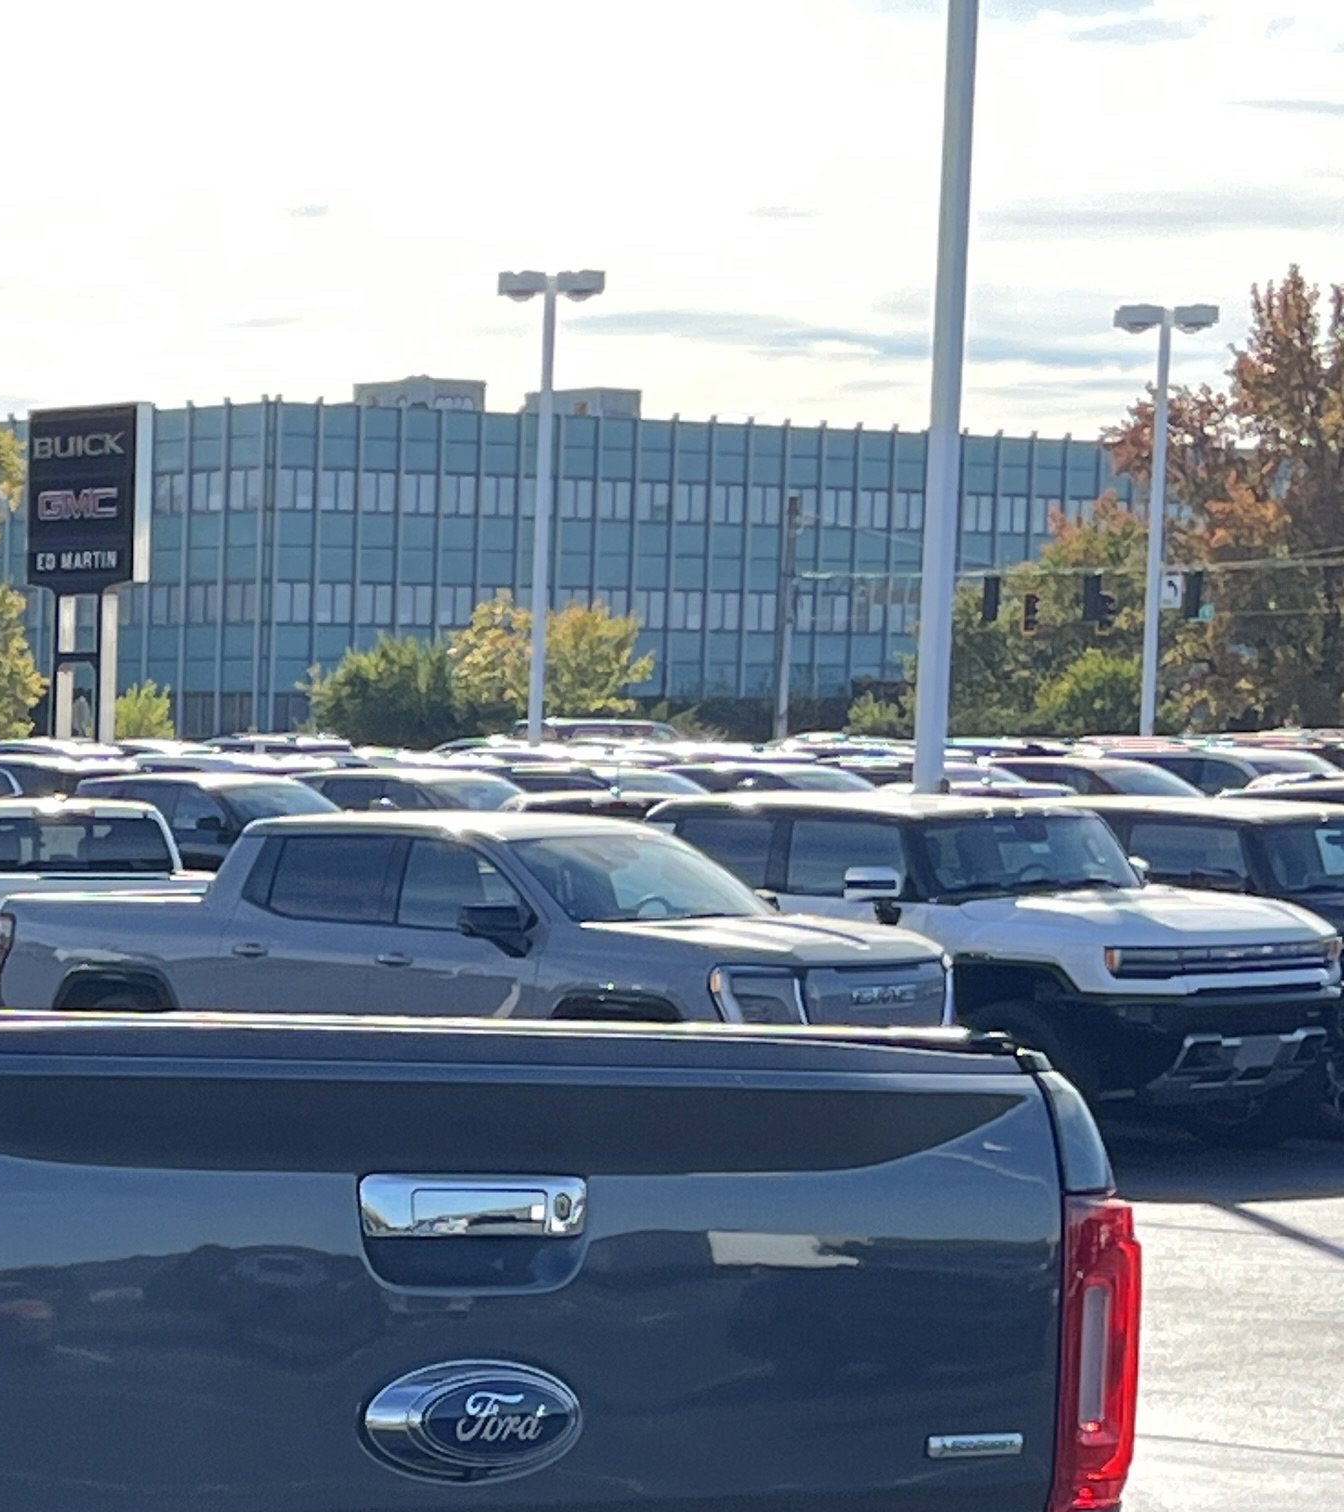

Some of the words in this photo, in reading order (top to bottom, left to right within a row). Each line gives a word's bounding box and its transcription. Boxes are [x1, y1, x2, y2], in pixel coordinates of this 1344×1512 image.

[32, 431, 125, 459] BUICK
[37, 487, 118, 521] GMC
[36, 552, 56, 571] ED
[60, 551, 117, 570] MARTIN
[455, 1391, 545, 1442] Ford
